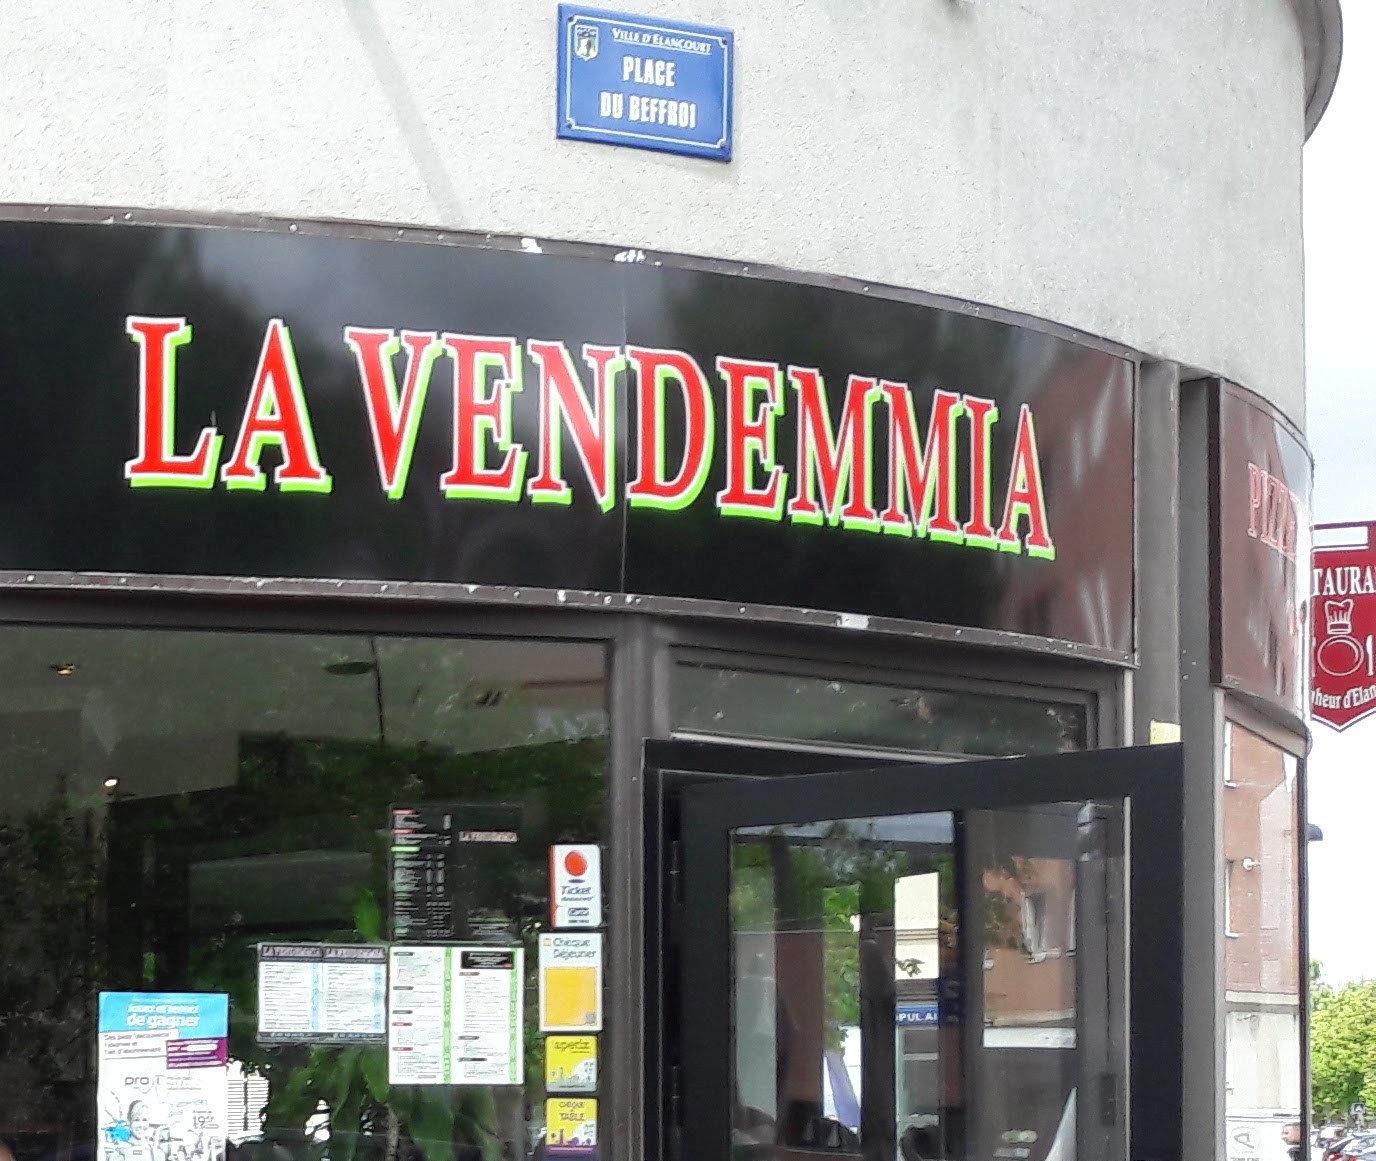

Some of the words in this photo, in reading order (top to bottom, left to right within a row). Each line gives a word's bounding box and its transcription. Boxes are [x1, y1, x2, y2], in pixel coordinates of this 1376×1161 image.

[623, 56, 676, 87] PLACE
[600, 91, 623, 119] DU
[628, 94, 696, 128] BEFFROI
[125, 315, 333, 494] LA
[345, 325, 1056, 560] VENDEMMIA
[1312, 565, 1376, 597] TAURA
[560, 886, 592, 895] Ticket
[127, 1013, 146, 1026] de
[147, 1014, 200, 1028] gagner
